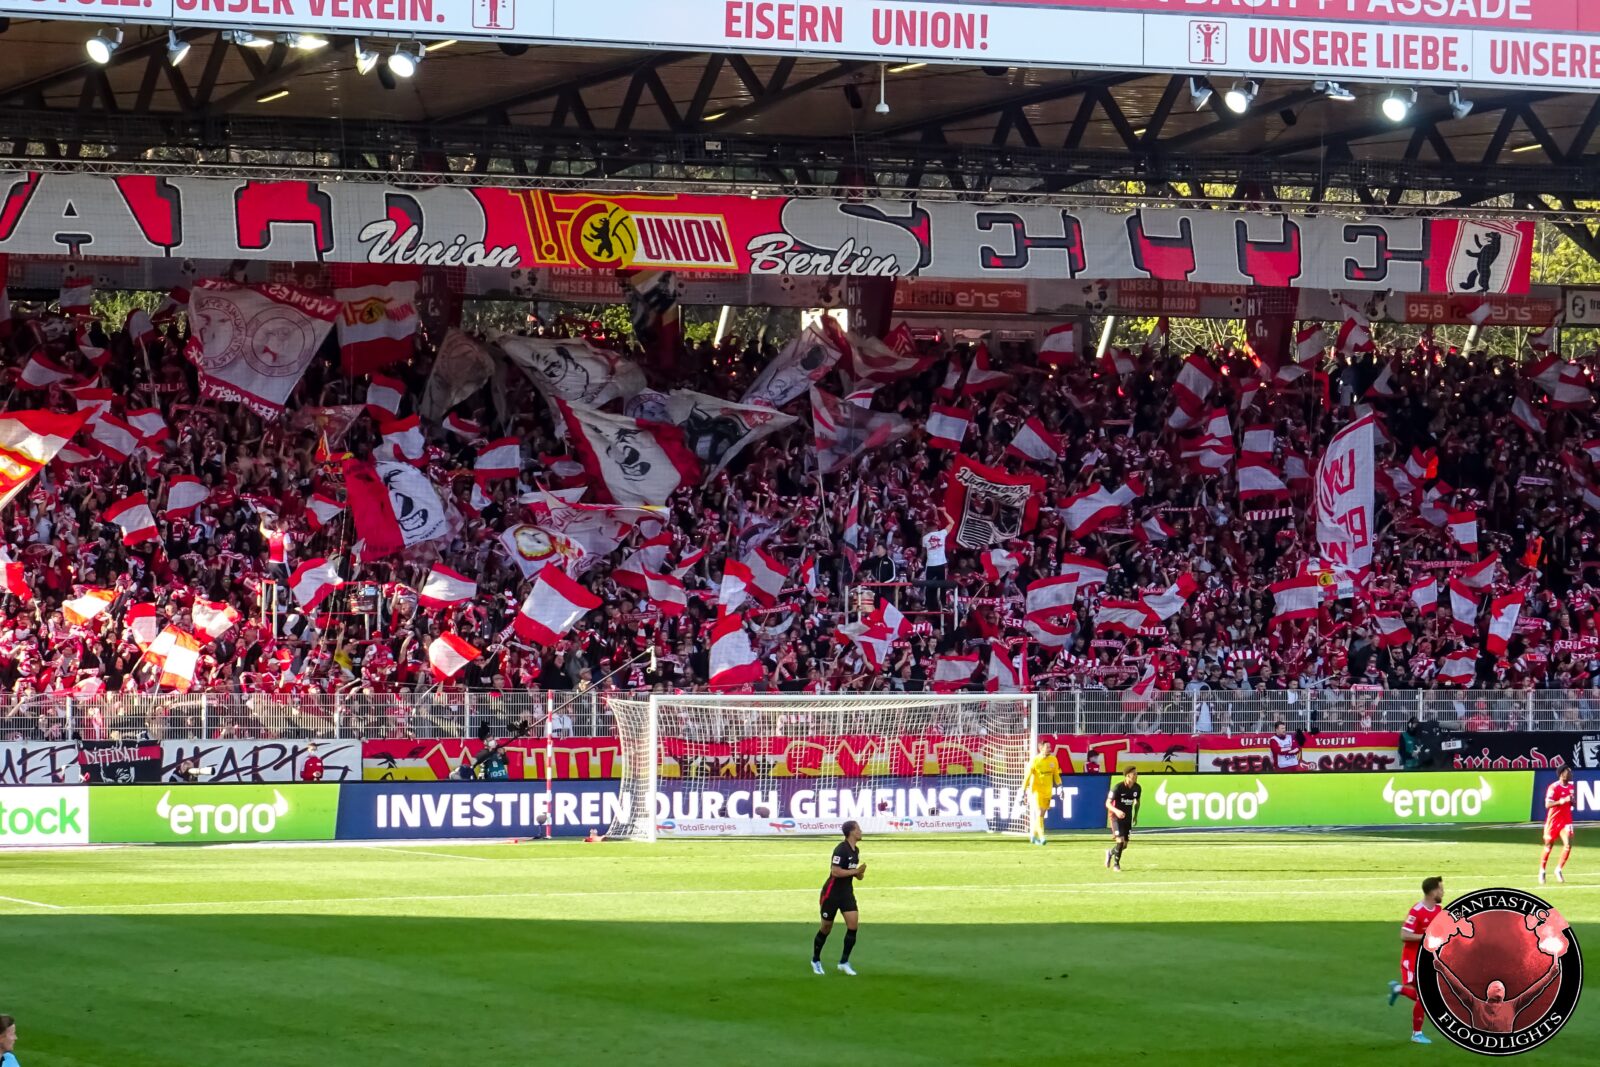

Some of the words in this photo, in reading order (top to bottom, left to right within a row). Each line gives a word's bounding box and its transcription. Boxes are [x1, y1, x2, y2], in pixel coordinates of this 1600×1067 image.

[724, 0, 844, 43] EISERN
[872, 8, 989, 50] UNION!
[1248, 26, 1367, 67] UNSERE
[1376, 32, 1469, 73] LIEBE.
[359, 219, 520, 267] Union
[635, 217, 732, 263] UNION
[747, 233, 900, 276] Berlin
[376, 793, 630, 829] INVESTIEREN
